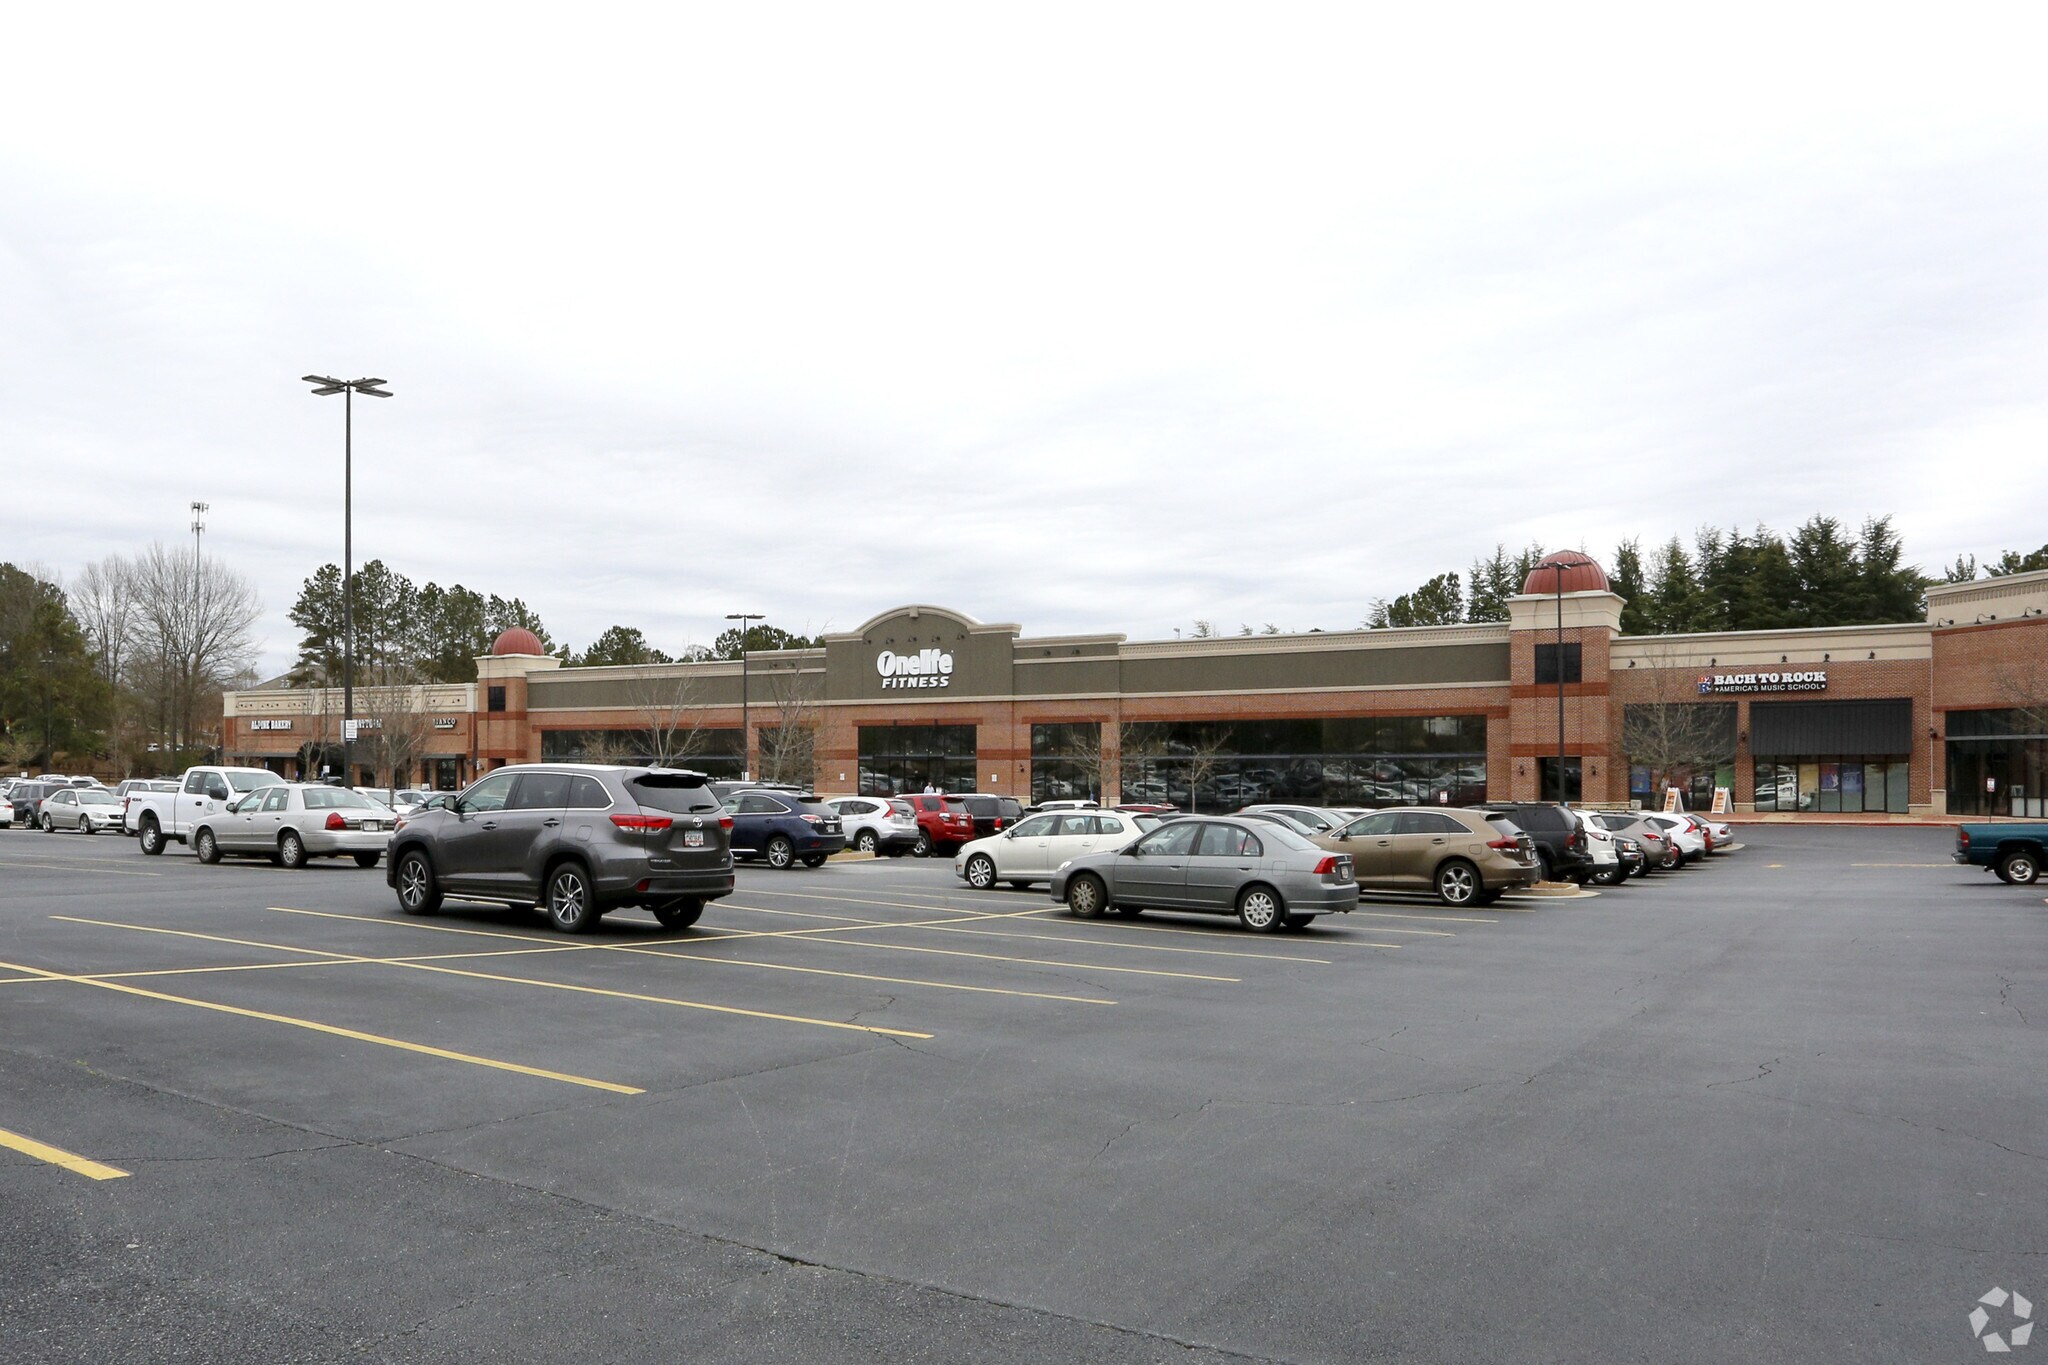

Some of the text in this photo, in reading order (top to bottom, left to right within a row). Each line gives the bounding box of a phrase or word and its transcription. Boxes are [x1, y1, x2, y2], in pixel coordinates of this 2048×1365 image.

[877, 648, 953, 677] Onelife
[882, 676, 949, 689] FITNESS
[1714, 671, 1826, 685] BACH TO ROCK
[1761, 683, 1785, 691] MUSIC
[271, 720, 291, 730] BAKERY
